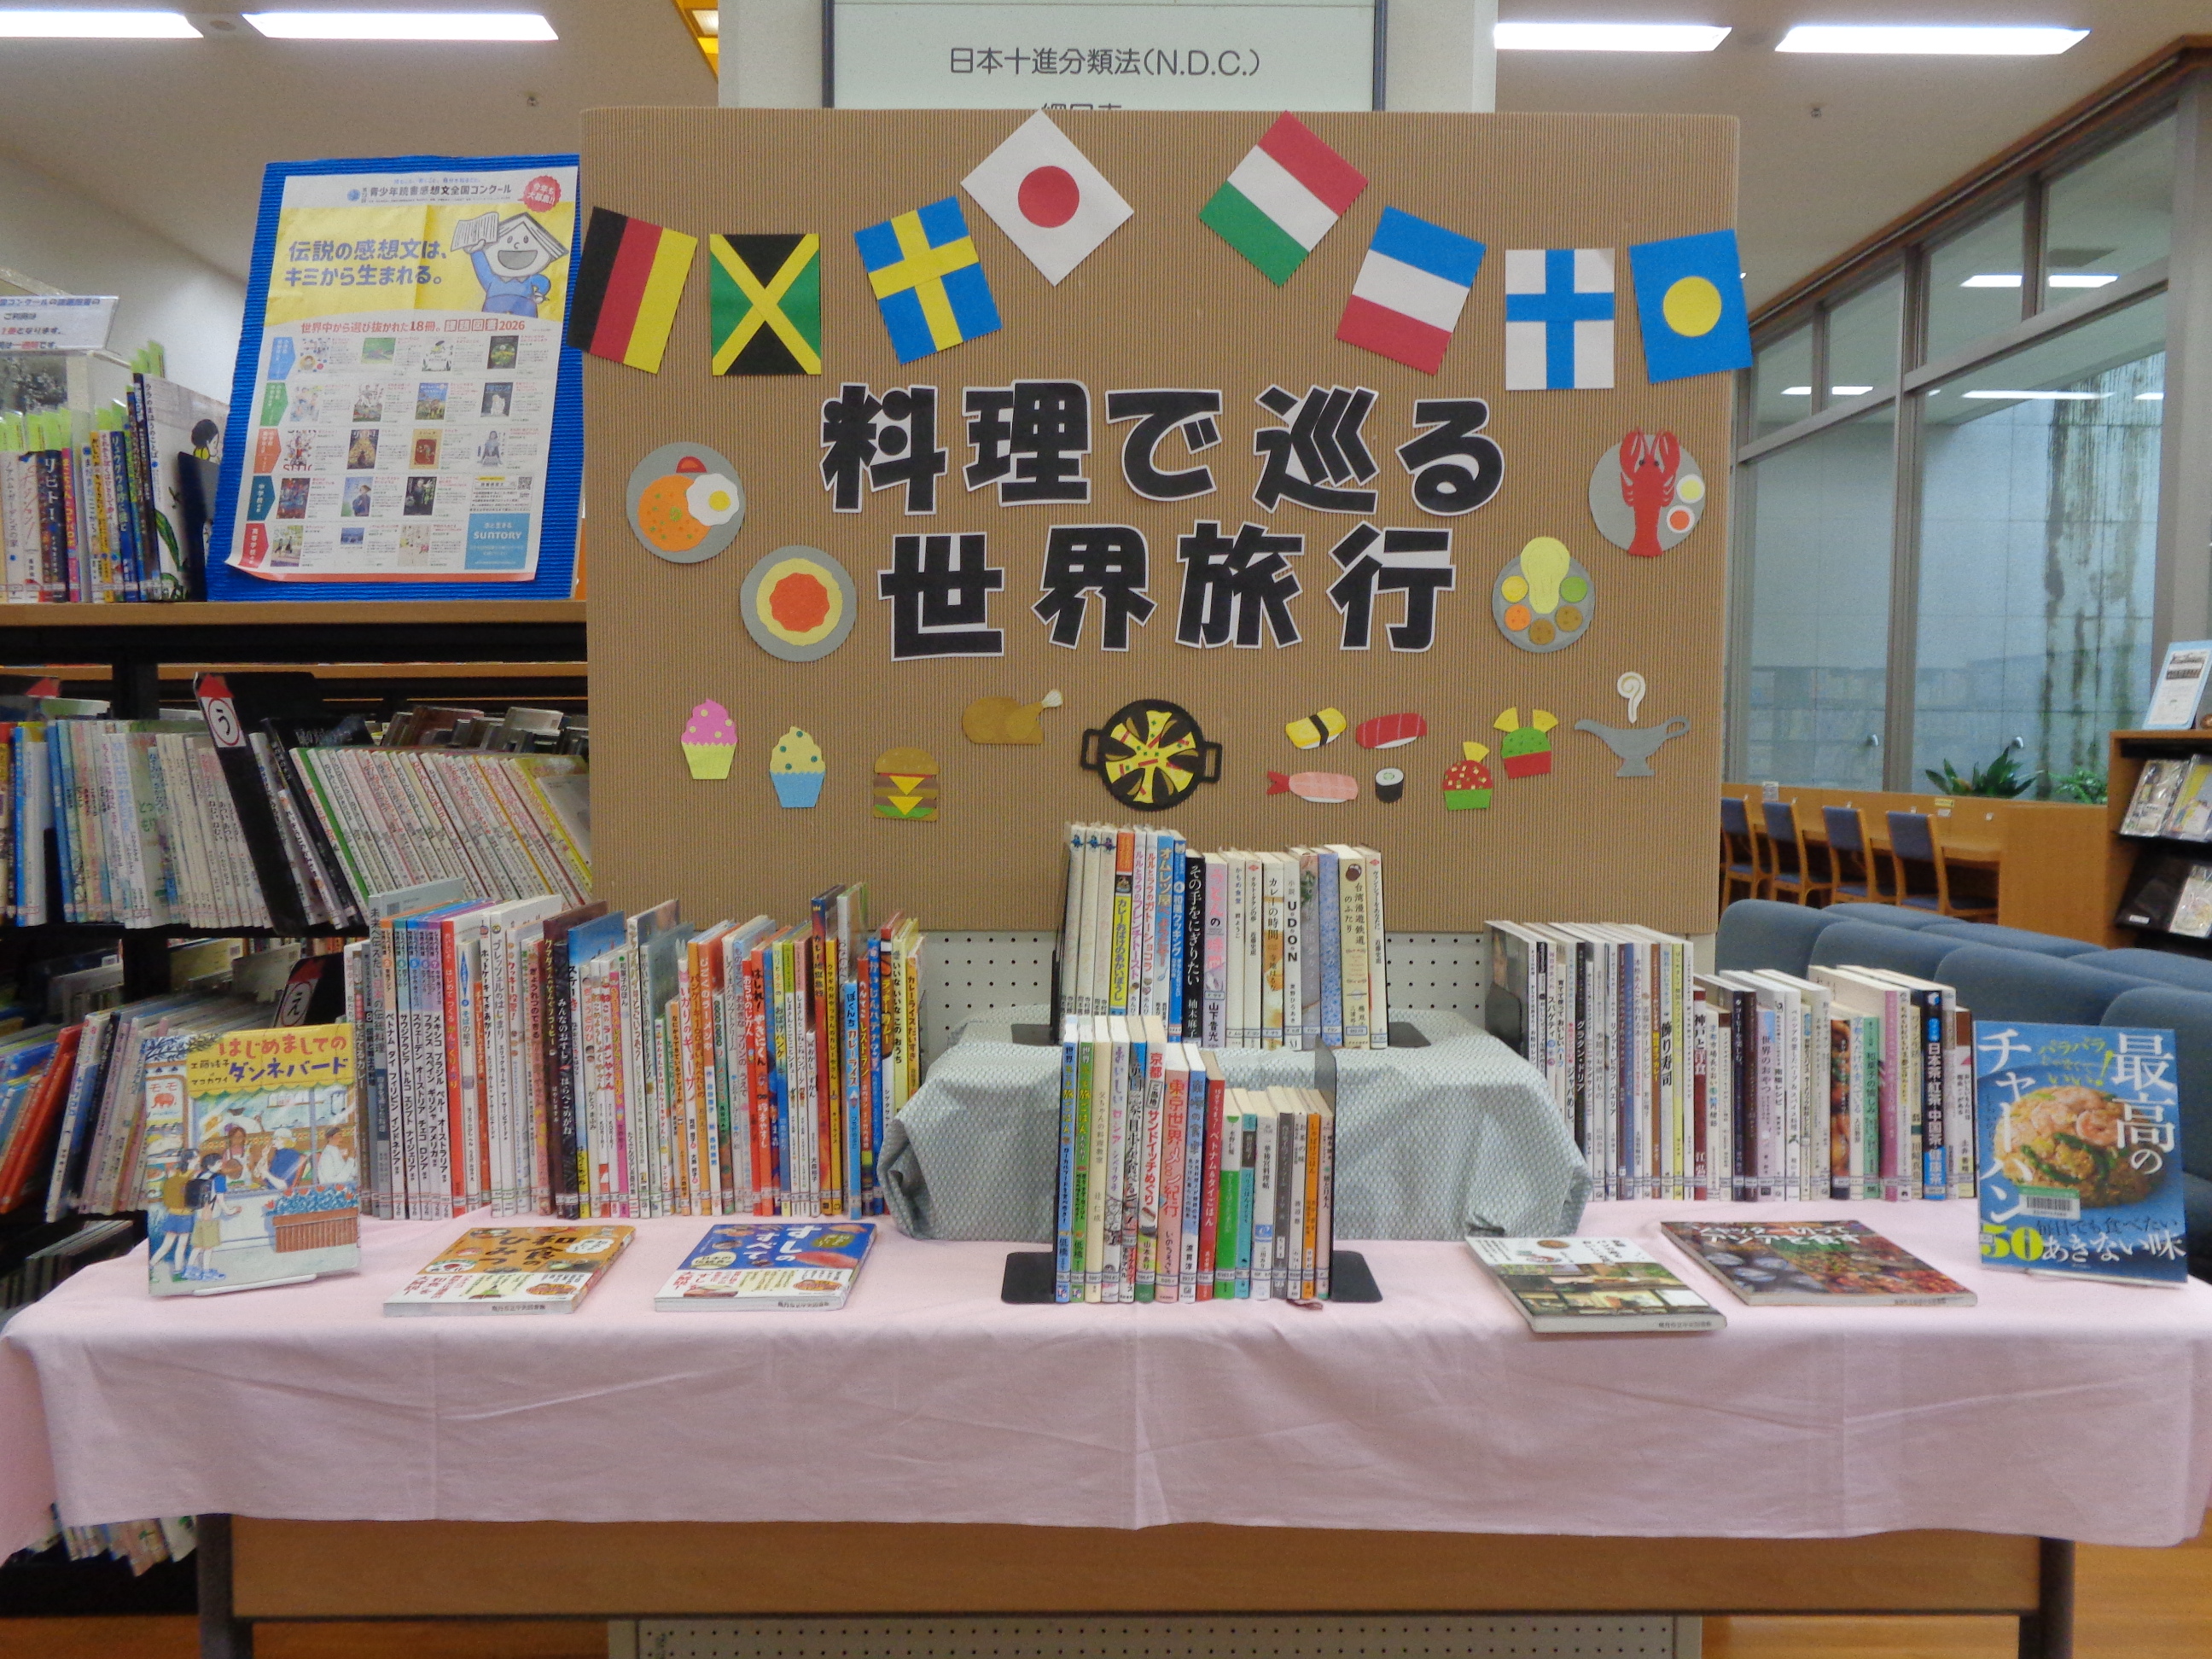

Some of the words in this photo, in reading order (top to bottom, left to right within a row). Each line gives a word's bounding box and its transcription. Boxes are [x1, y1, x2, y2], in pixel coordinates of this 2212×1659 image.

[949, 48, 1261, 78] 日本十進分類法(N.D.C.)
[370, 184, 512, 196] 青少年読書感想文全国コンクール
[288, 238, 447, 262] 伝説の感想文は、
[284, 265, 443, 287] キミから生まれる。
[819, 379, 1505, 515] 料理で巡る
[878, 519, 1456, 661] 世界旅行
[214, 712, 234, 736] う
[1131, 851, 1145, 981] ルルとララのフレンチトースト
[1172, 896, 1184, 957] 和風クッキング
[1187, 864, 1202, 986] その手をにぎりたい
[1268, 877, 1278, 940] カレーの時間
[1344, 896, 1353, 934] のふたり
[1354, 882, 1365, 946] 台湾漫遊鉄道
[445, 969, 454, 998] はじめて
[480, 949, 490, 992] ホットケーキ
[492, 940, 505, 1039] プレッツェルのはじまり
[620, 962, 629, 1006] 和菓子のほん
[284, 990, 308, 1017] え
[446, 1003, 455, 1022] つくる
[700, 958, 713, 1051] じごくのラーメンや
[742, 975, 754, 1036] おちゃのじかん
[847, 992, 855, 1027] ぼくんち
[882, 981, 890, 1013] ラッキー
[386, 1014, 395, 1045] ベトナム
[413, 1014, 422, 1060] スウェーデン
[424, 1014, 434, 1047] フランス
[434, 1014, 443, 1047] メキシコ
[483, 996, 492, 1049] できあがり!
[557, 998, 568, 1059] みんなのおすし
[882, 1014, 892, 1044] カレー
[894, 1019, 902, 1033] この
[908, 976, 917, 1063] カレーライスだいすき
[218, 1033, 347, 1059] はじめましての
[399, 1014, 410, 1065] サウジアラビア
[736, 1034, 747, 1066] プリンの
[754, 1014, 766, 1066] やきにくん
[847, 1029, 859, 1086] カレーライス
[860, 1022, 870, 1077] レストラン
[1576, 1020, 1586, 1092] グラタン・ドリア
[2040, 1038, 2106, 1054] パラパラ
[229, 1057, 349, 1083] ダンネバード
[387, 1052, 395, 1067] タイ
[426, 1052, 434, 1083] スペイン
[434, 1052, 445, 1086] ブラジル
[1113, 1046, 1125, 1103] おいしい
[1149, 1052, 1163, 1079] 京都
[1761, 1035, 1772, 1092] 世界のおやつ
[388, 1073, 398, 1111] フィリピン
[415, 1067, 426, 1115] オーストリア
[436, 1091, 445, 1113] ペルー
[739, 1073, 748, 1097] うえで
[2110, 1032, 2178, 1175] 最高の
[405, 1097, 413, 1124] エジプト
[427, 1090, 437, 1120] ギリシャ
[560, 1077, 573, 1135] はらぺこめがね
[391, 1117, 401, 1165] インドネシア
[418, 1120, 427, 1142] チェコ
[428, 1126, 438, 1158] アメリカ
[1977, 1027, 2036, 1224] チャーハン
[405, 1131, 416, 1172] ナイジェリア
[419, 1147, 428, 1171] ロシア
[438, 1119, 449, 1173] オーストラリア
[1144, 1109, 1160, 1206] サンドイッチめぐり
[1204, 1130, 1221, 1227] ベトナム&タイごはん
[743, 1231, 780, 1260] すべて
[775, 1225, 823, 1262] すしの
[1980, 1223, 2045, 1262] 50
[2042, 1230, 2186, 1264] あきない味
